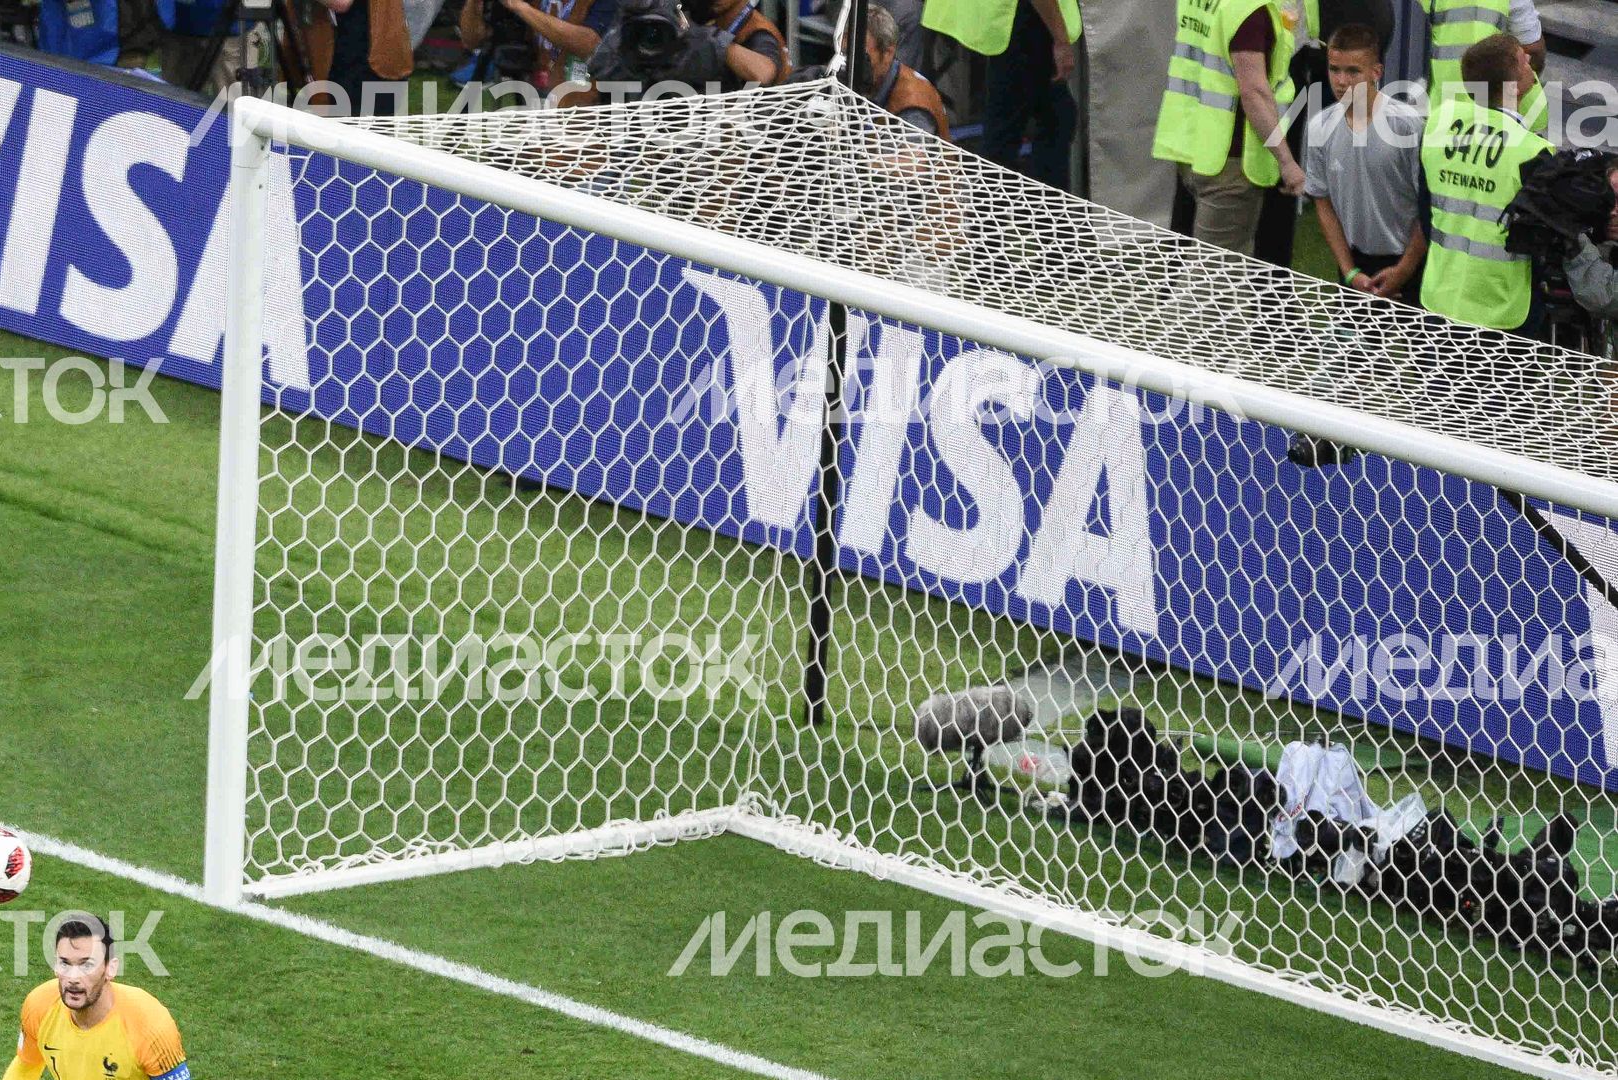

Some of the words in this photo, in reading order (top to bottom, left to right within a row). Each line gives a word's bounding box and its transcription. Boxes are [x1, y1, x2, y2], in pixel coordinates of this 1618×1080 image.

[1444, 119, 1509, 169] 3470
[1439, 169, 1496, 193] STEWARD
[681, 267, 1158, 636] VISA
